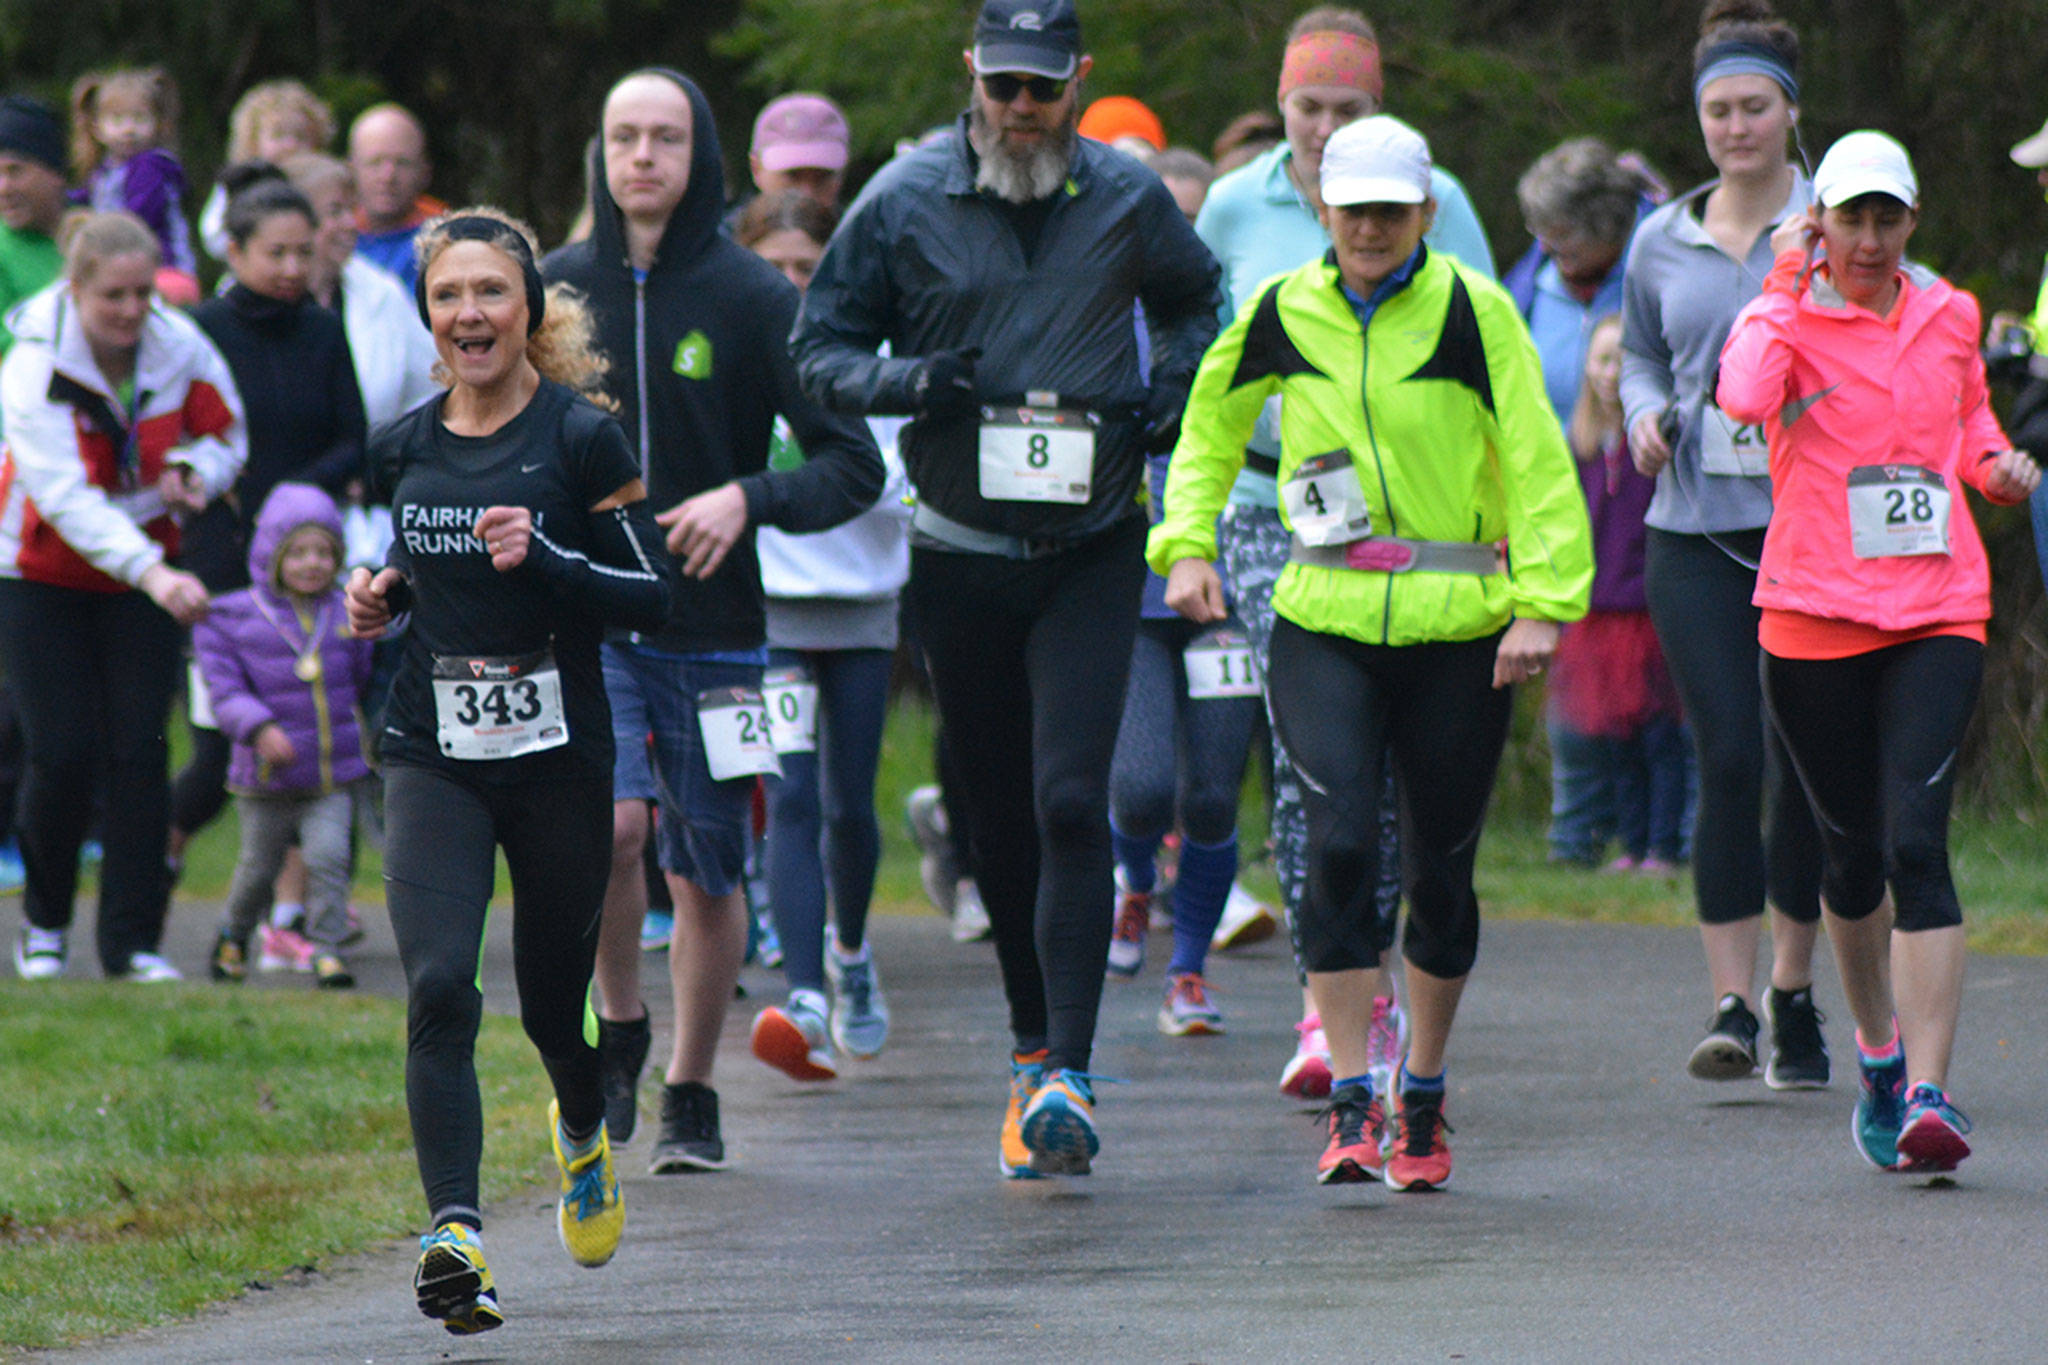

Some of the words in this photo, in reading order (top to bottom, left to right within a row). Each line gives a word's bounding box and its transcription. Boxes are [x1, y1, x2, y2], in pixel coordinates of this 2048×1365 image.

[1028, 433, 1049, 468] 8
[1732, 425, 1768, 446] 2
[1304, 482, 1327, 515] 4
[1884, 488, 1933, 525] 28
[1219, 654, 1253, 685] 11
[454, 680, 542, 726] 343
